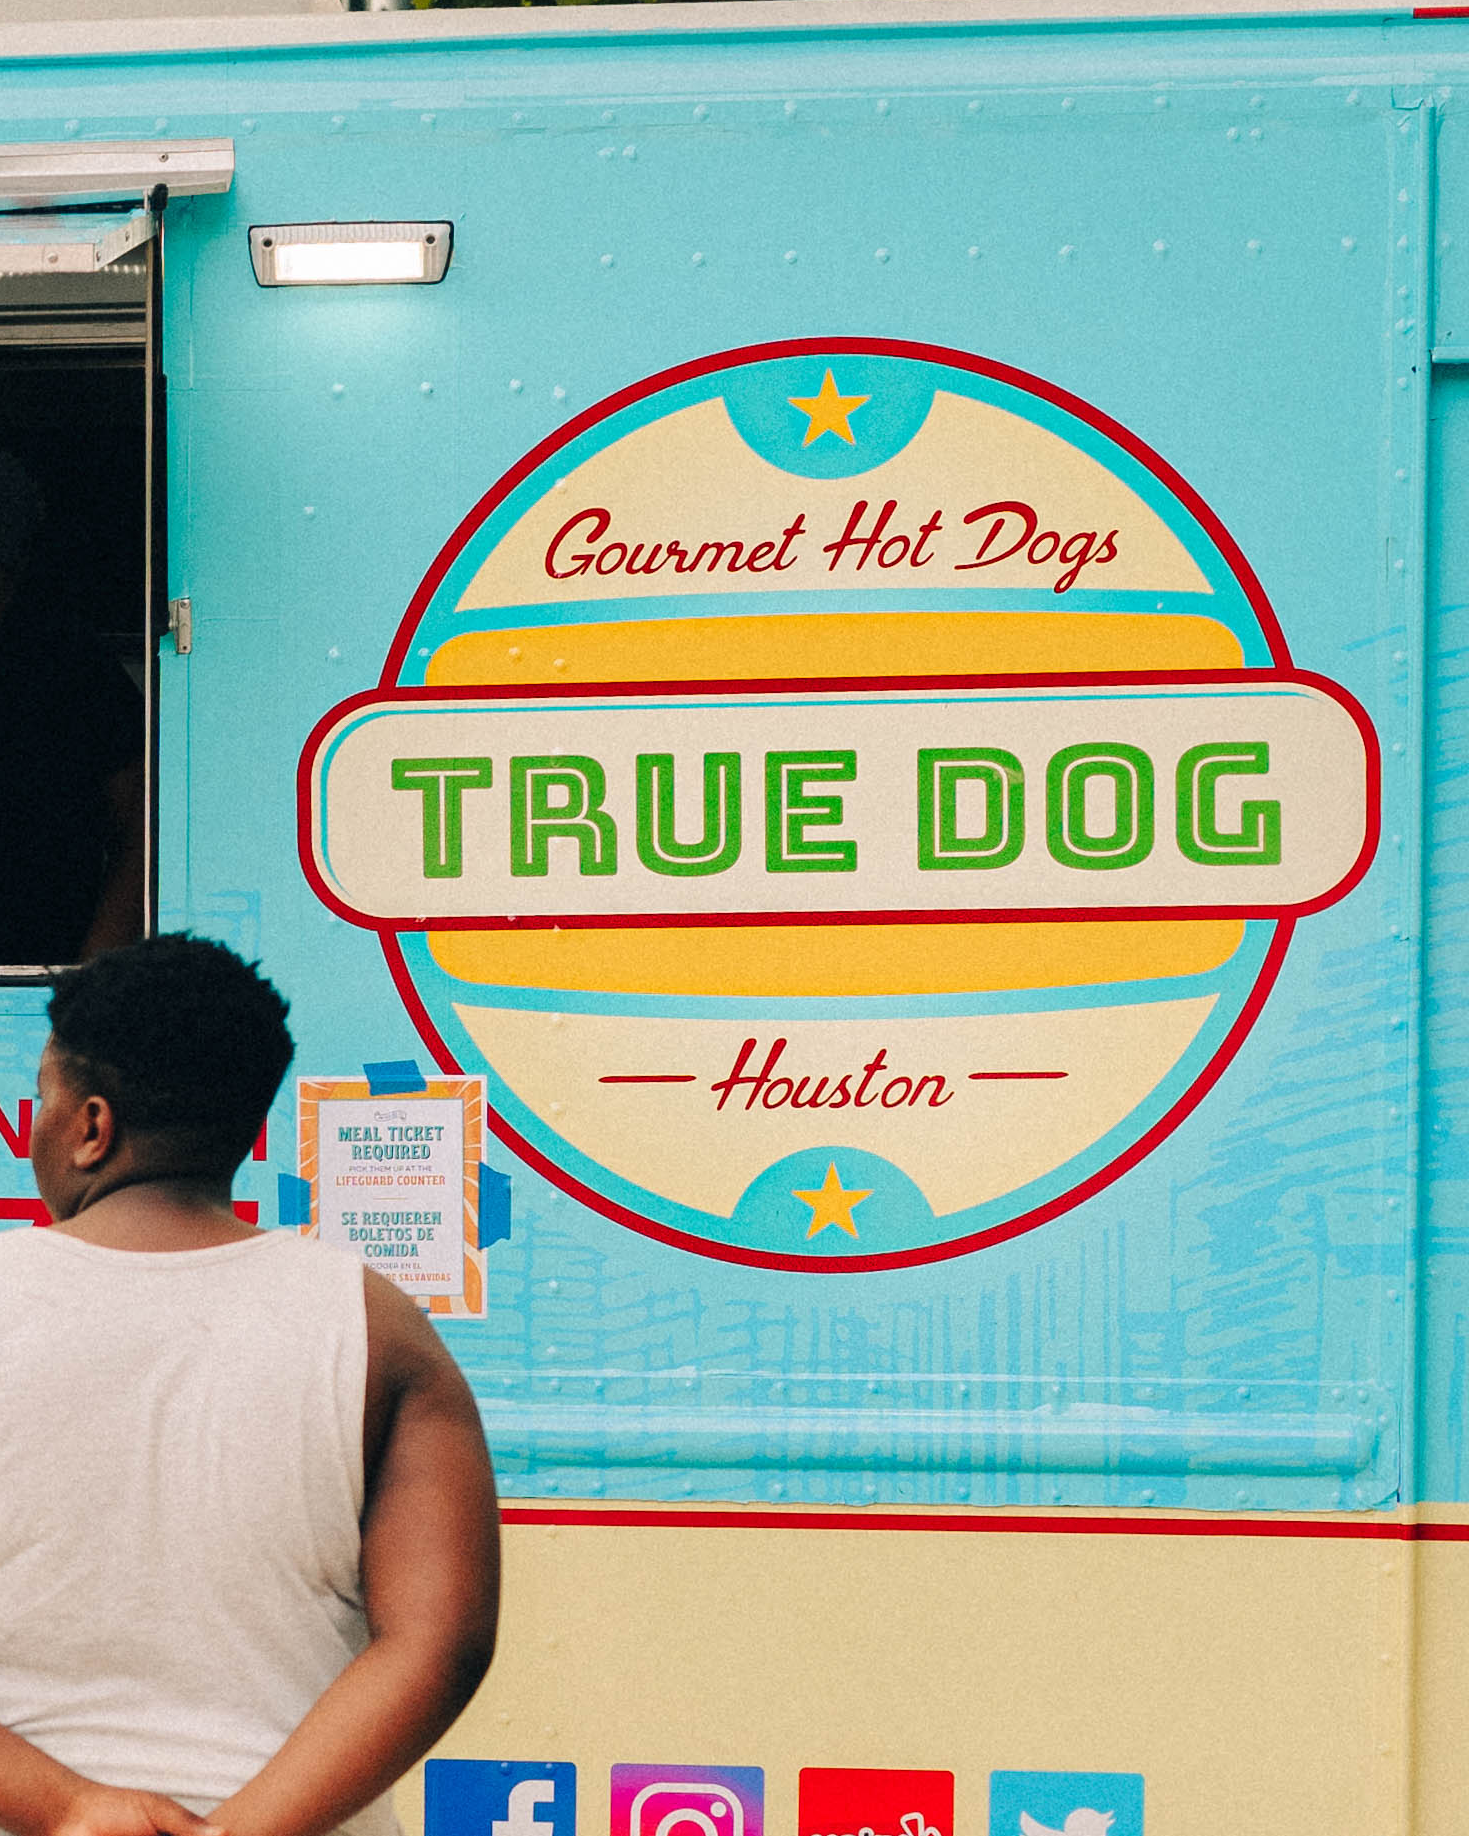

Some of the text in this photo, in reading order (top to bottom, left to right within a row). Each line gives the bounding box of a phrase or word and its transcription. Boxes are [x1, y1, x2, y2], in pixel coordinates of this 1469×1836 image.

[545, 499, 1119, 593] Gourmet Hot Dogs
[391, 742, 1283, 879] TRUE DOG
[710, 1038, 955, 1111] Houston
[337, 1125, 445, 1142] MEAL TICKET
[351, 1144, 431, 1162] REQUIRED
[369, 1165, 391, 1173] THEM
[405, 1165, 416, 1173] AT
[417, 1164, 432, 1172] THE
[336, 1174, 446, 1186] LIFEGUARD COUNTER
[341, 1210, 442, 1227] SE REQUIEREN
[348, 1227, 435, 1242] BOLETOS DE
[364, 1243, 419, 1258] COMIDA
